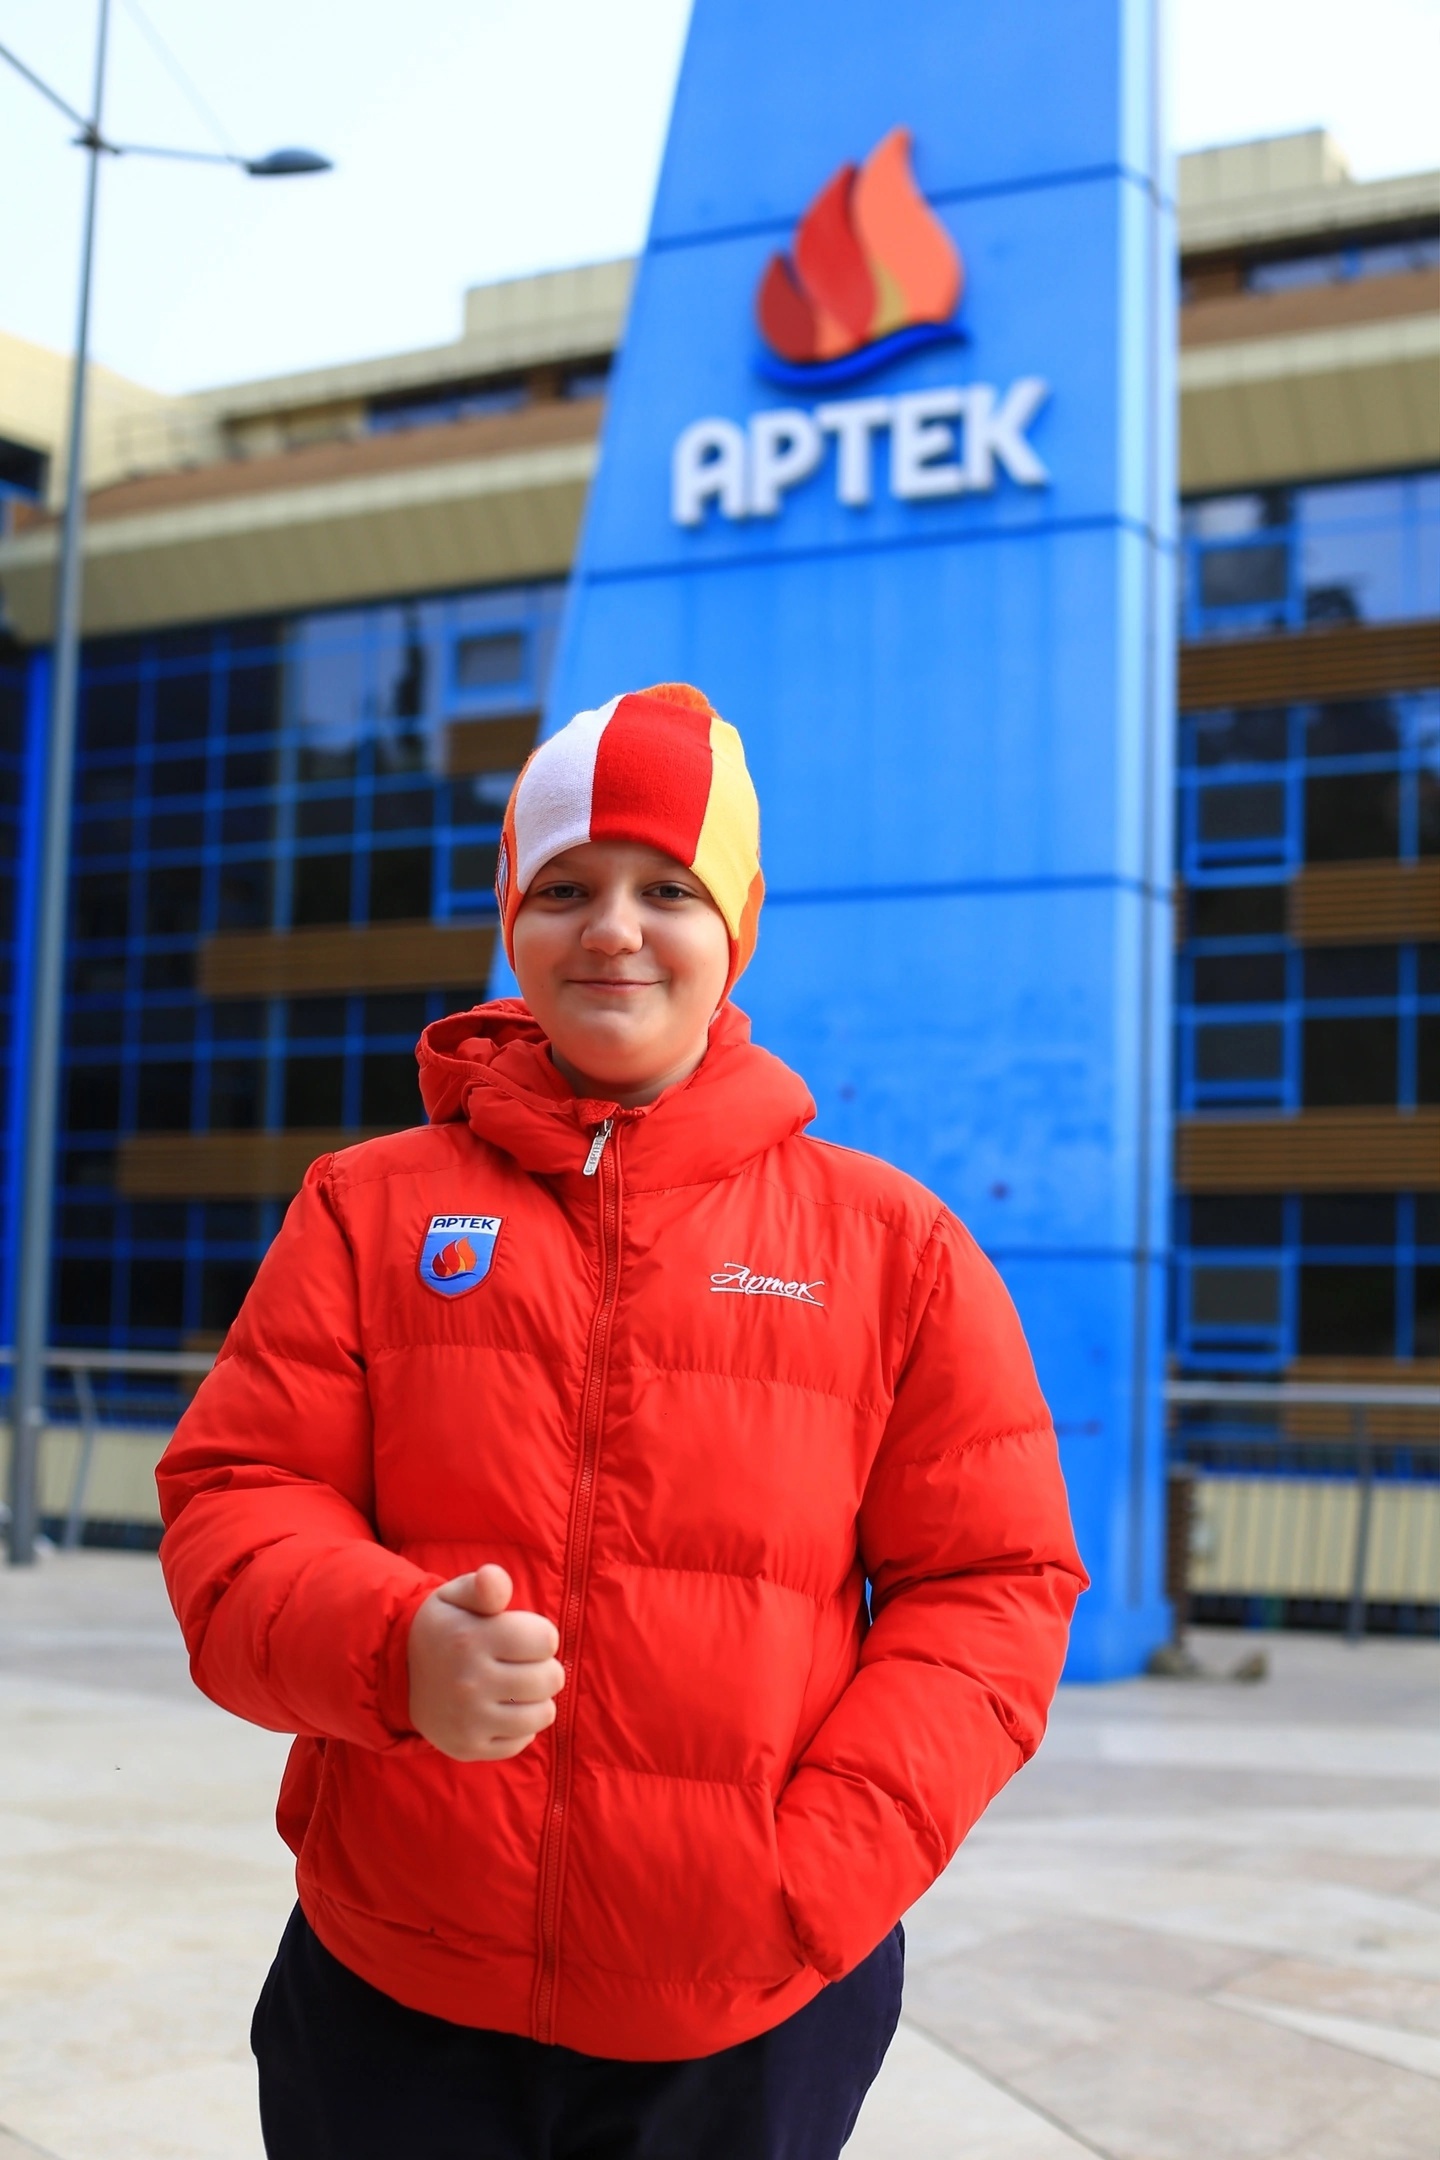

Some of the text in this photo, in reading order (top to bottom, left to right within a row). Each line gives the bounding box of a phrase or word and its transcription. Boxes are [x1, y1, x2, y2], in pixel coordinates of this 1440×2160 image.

[671, 375, 1049, 526] АРТЕК
[432, 1217, 496, 1231] АРТЕК
[710, 1262, 825, 1301] Артек
